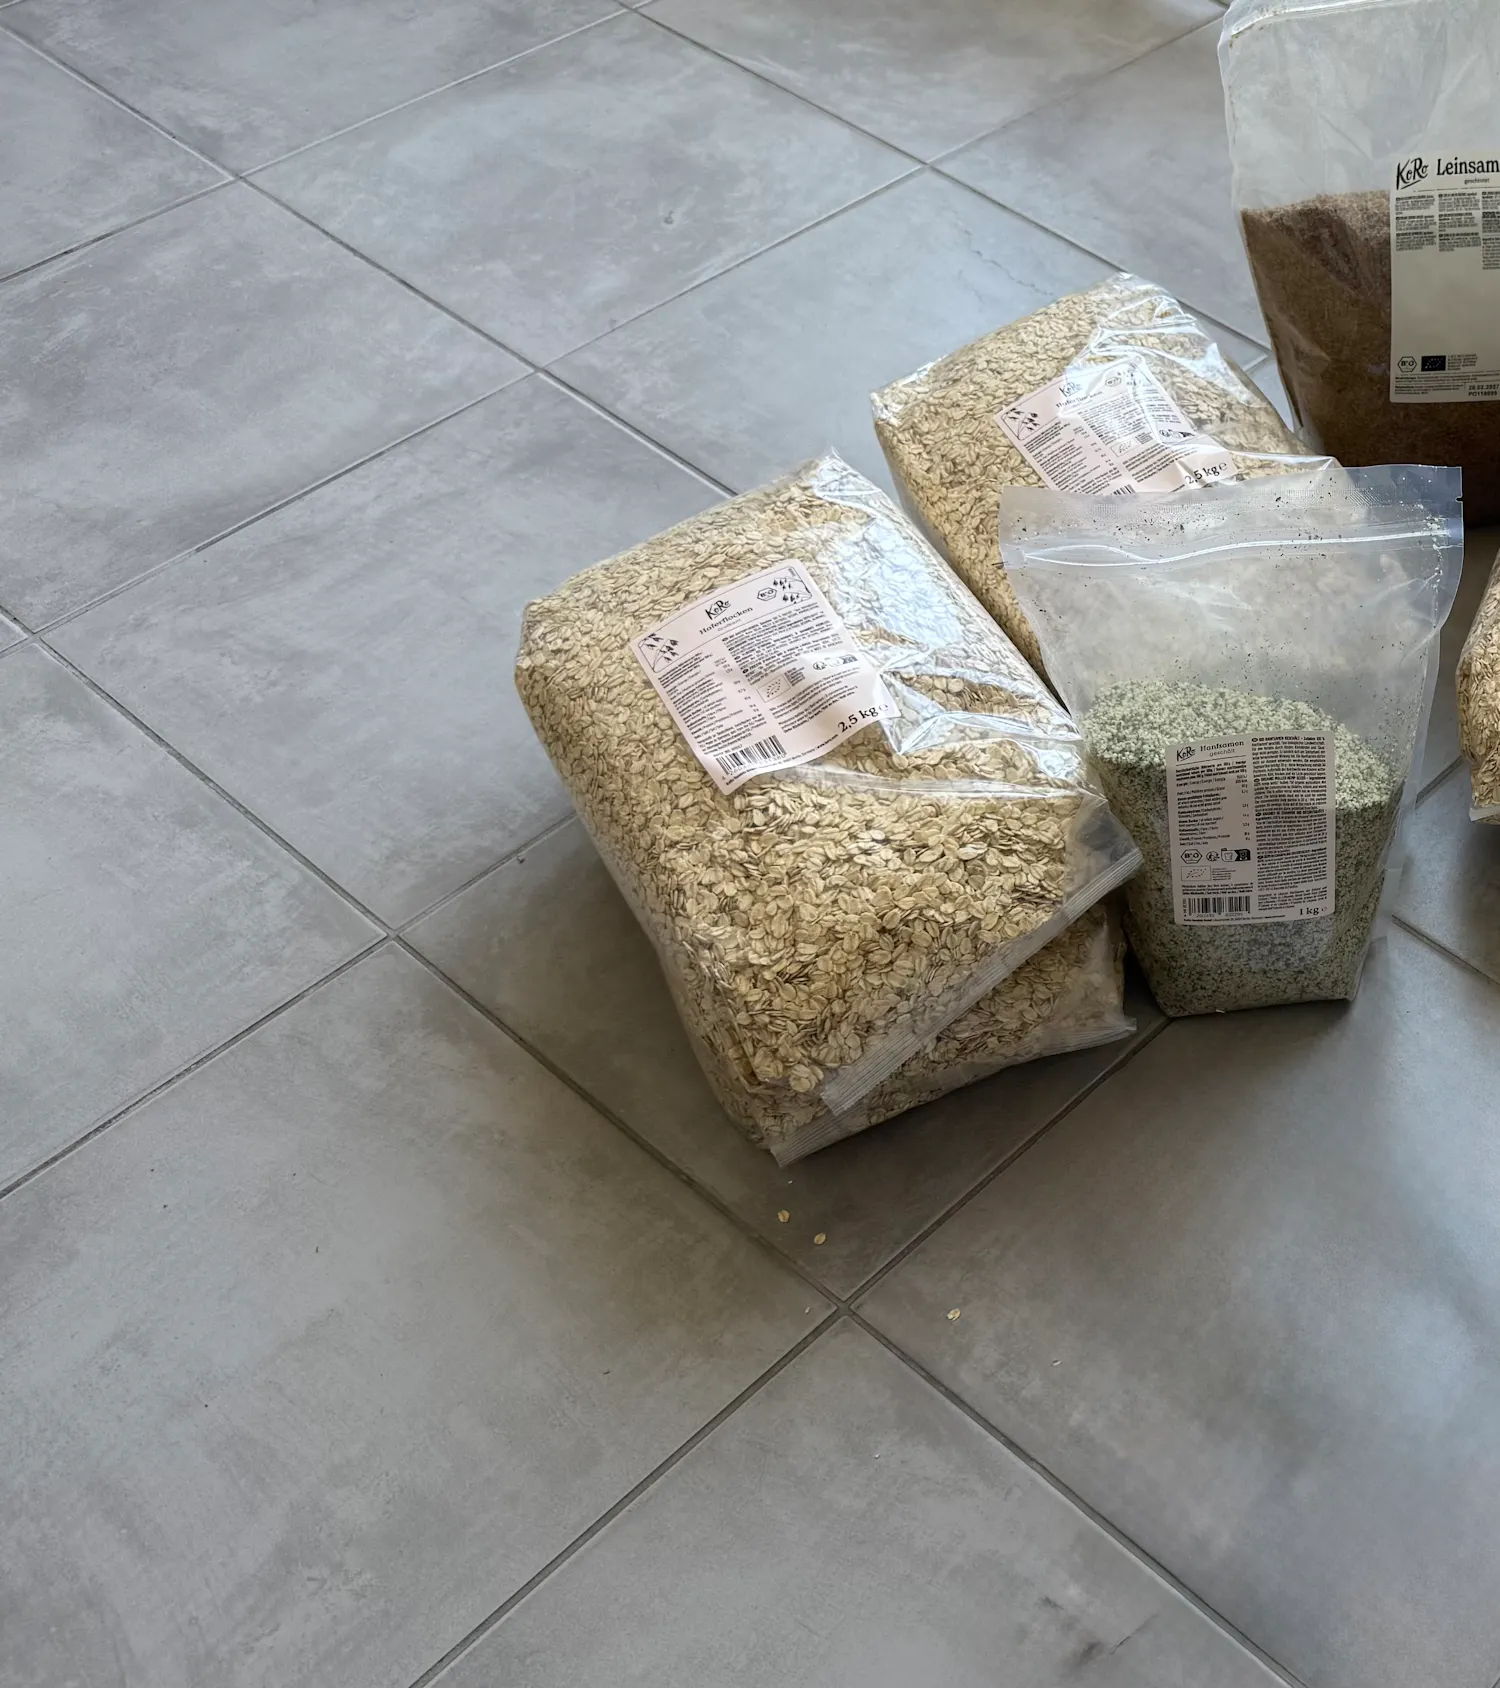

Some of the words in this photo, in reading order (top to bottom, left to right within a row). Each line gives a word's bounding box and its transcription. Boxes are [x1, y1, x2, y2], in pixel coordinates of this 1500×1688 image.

[1396, 157, 1429, 190] KoRo
[1185, 470, 1203, 485] 2,5
[1203, 466, 1220, 481] kg
[699, 606, 754, 635] Haferflocken
[704, 600, 732, 620] KoRo
[838, 714, 858, 734] 2,5
[858, 705, 880, 720] kg
[1176, 746, 1196, 762] KoRo
[1200, 741, 1245, 752] Hanfsamen
[1299, 908, 1304, 917] 1
[1306, 907, 1320, 917] kg
